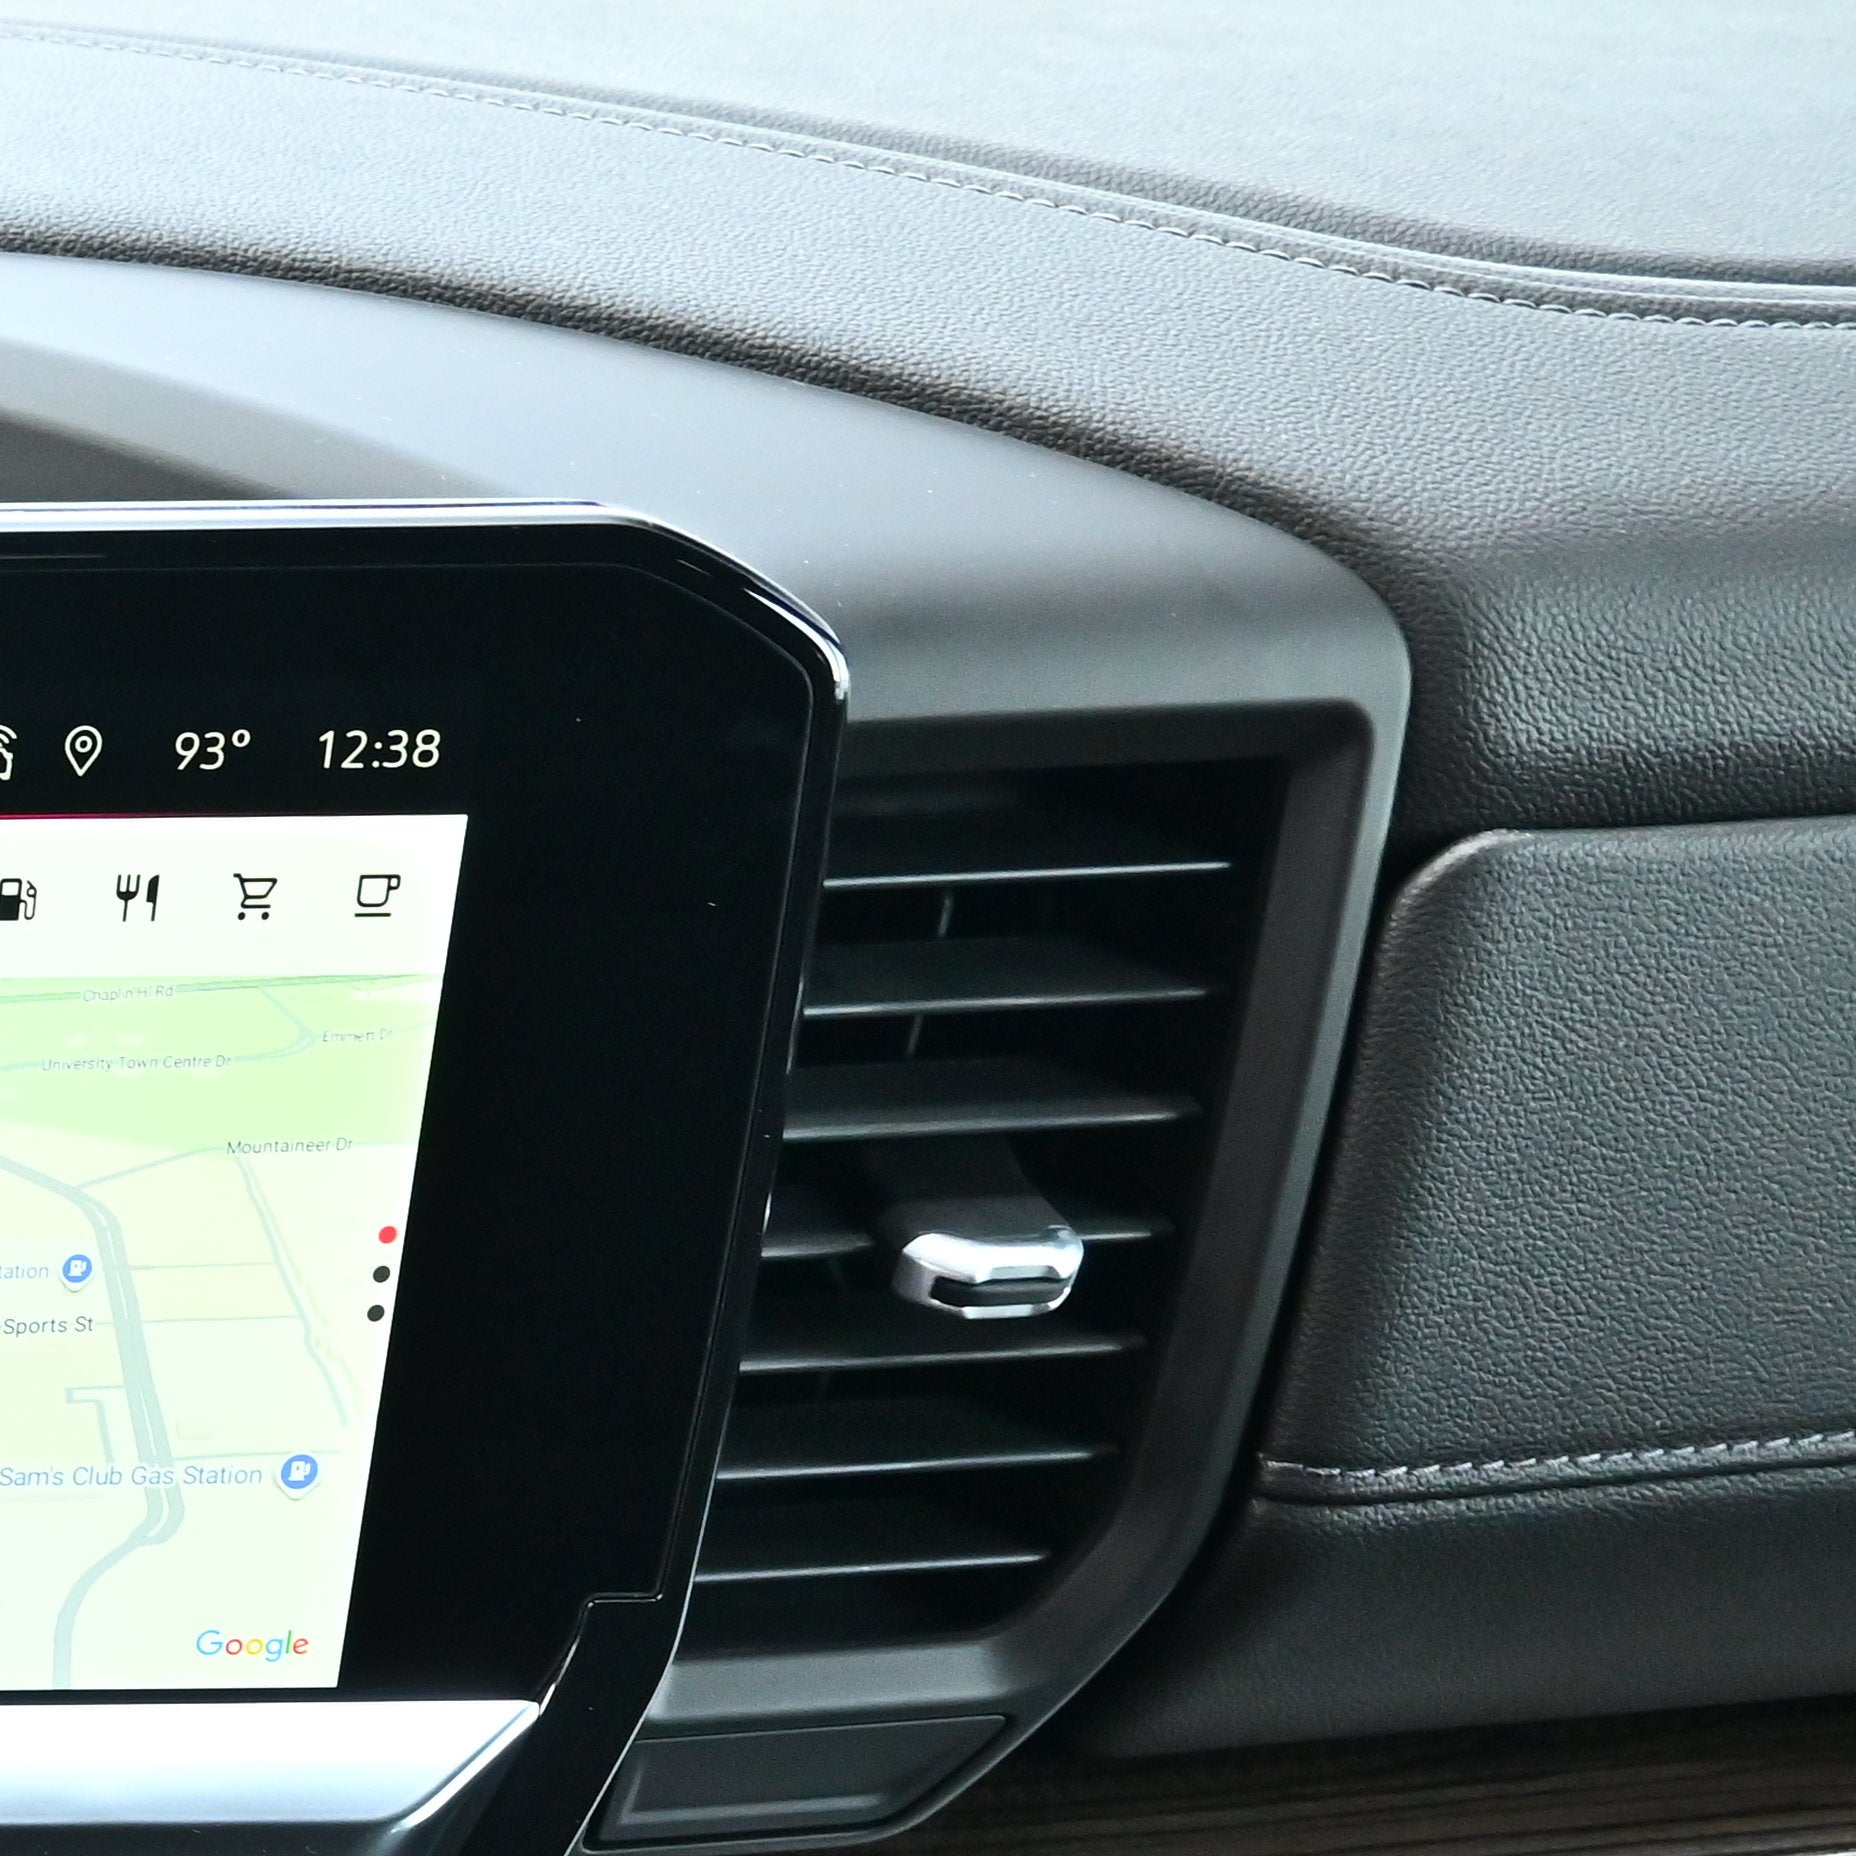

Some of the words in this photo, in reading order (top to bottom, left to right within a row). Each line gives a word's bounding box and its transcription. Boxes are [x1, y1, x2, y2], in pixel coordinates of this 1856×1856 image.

[175, 728, 251, 771] 93°
[318, 728, 441, 769] 12:38
[42, 1058, 111, 1072] University
[119, 1056, 158, 1069] Town
[163, 1054, 212, 1069] Centre
[215, 1054, 232, 1068] Dr
[226, 1140, 332, 1156] Mountaineer
[335, 1138, 354, 1152] Dr
[2, 1316, 68, 1338] Sports
[74, 1315, 94, 1333] St
[72, 1465, 123, 1487] Club
[130, 1465, 175, 1487] Gas
[182, 1464, 264, 1486] Station
[194, 1626, 312, 1664] Google
